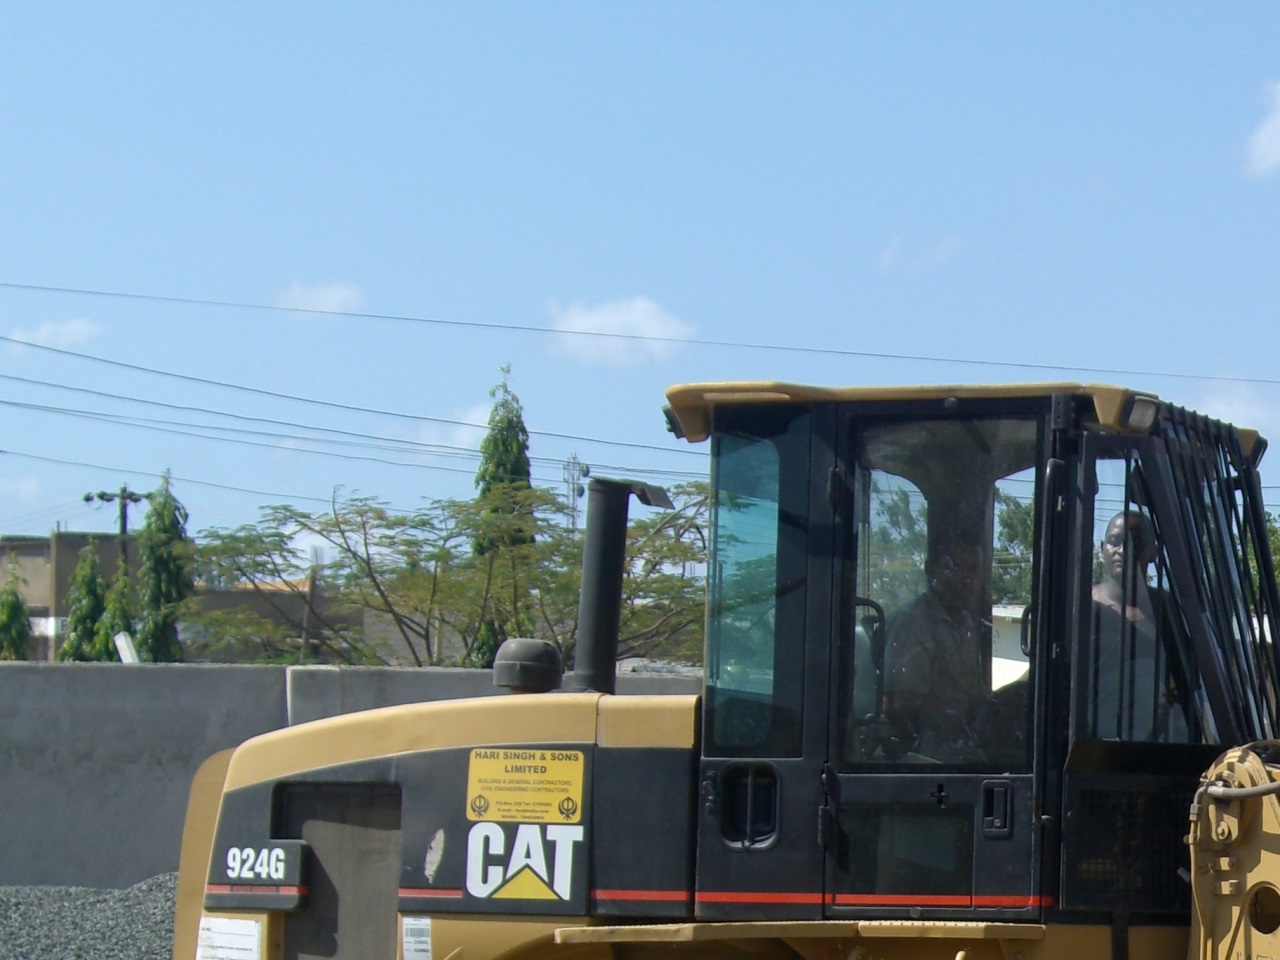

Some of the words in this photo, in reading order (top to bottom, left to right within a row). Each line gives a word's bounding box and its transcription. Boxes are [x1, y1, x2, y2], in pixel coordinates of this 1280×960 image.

[474, 750, 499, 760] HARI
[503, 751, 536, 761] SINGH
[539, 753, 547, 761] &
[550, 753, 579, 762] SONS
[504, 765, 547, 774] LIMITED
[226, 846, 286, 880] 924G
[466, 821, 584, 901] CAT
